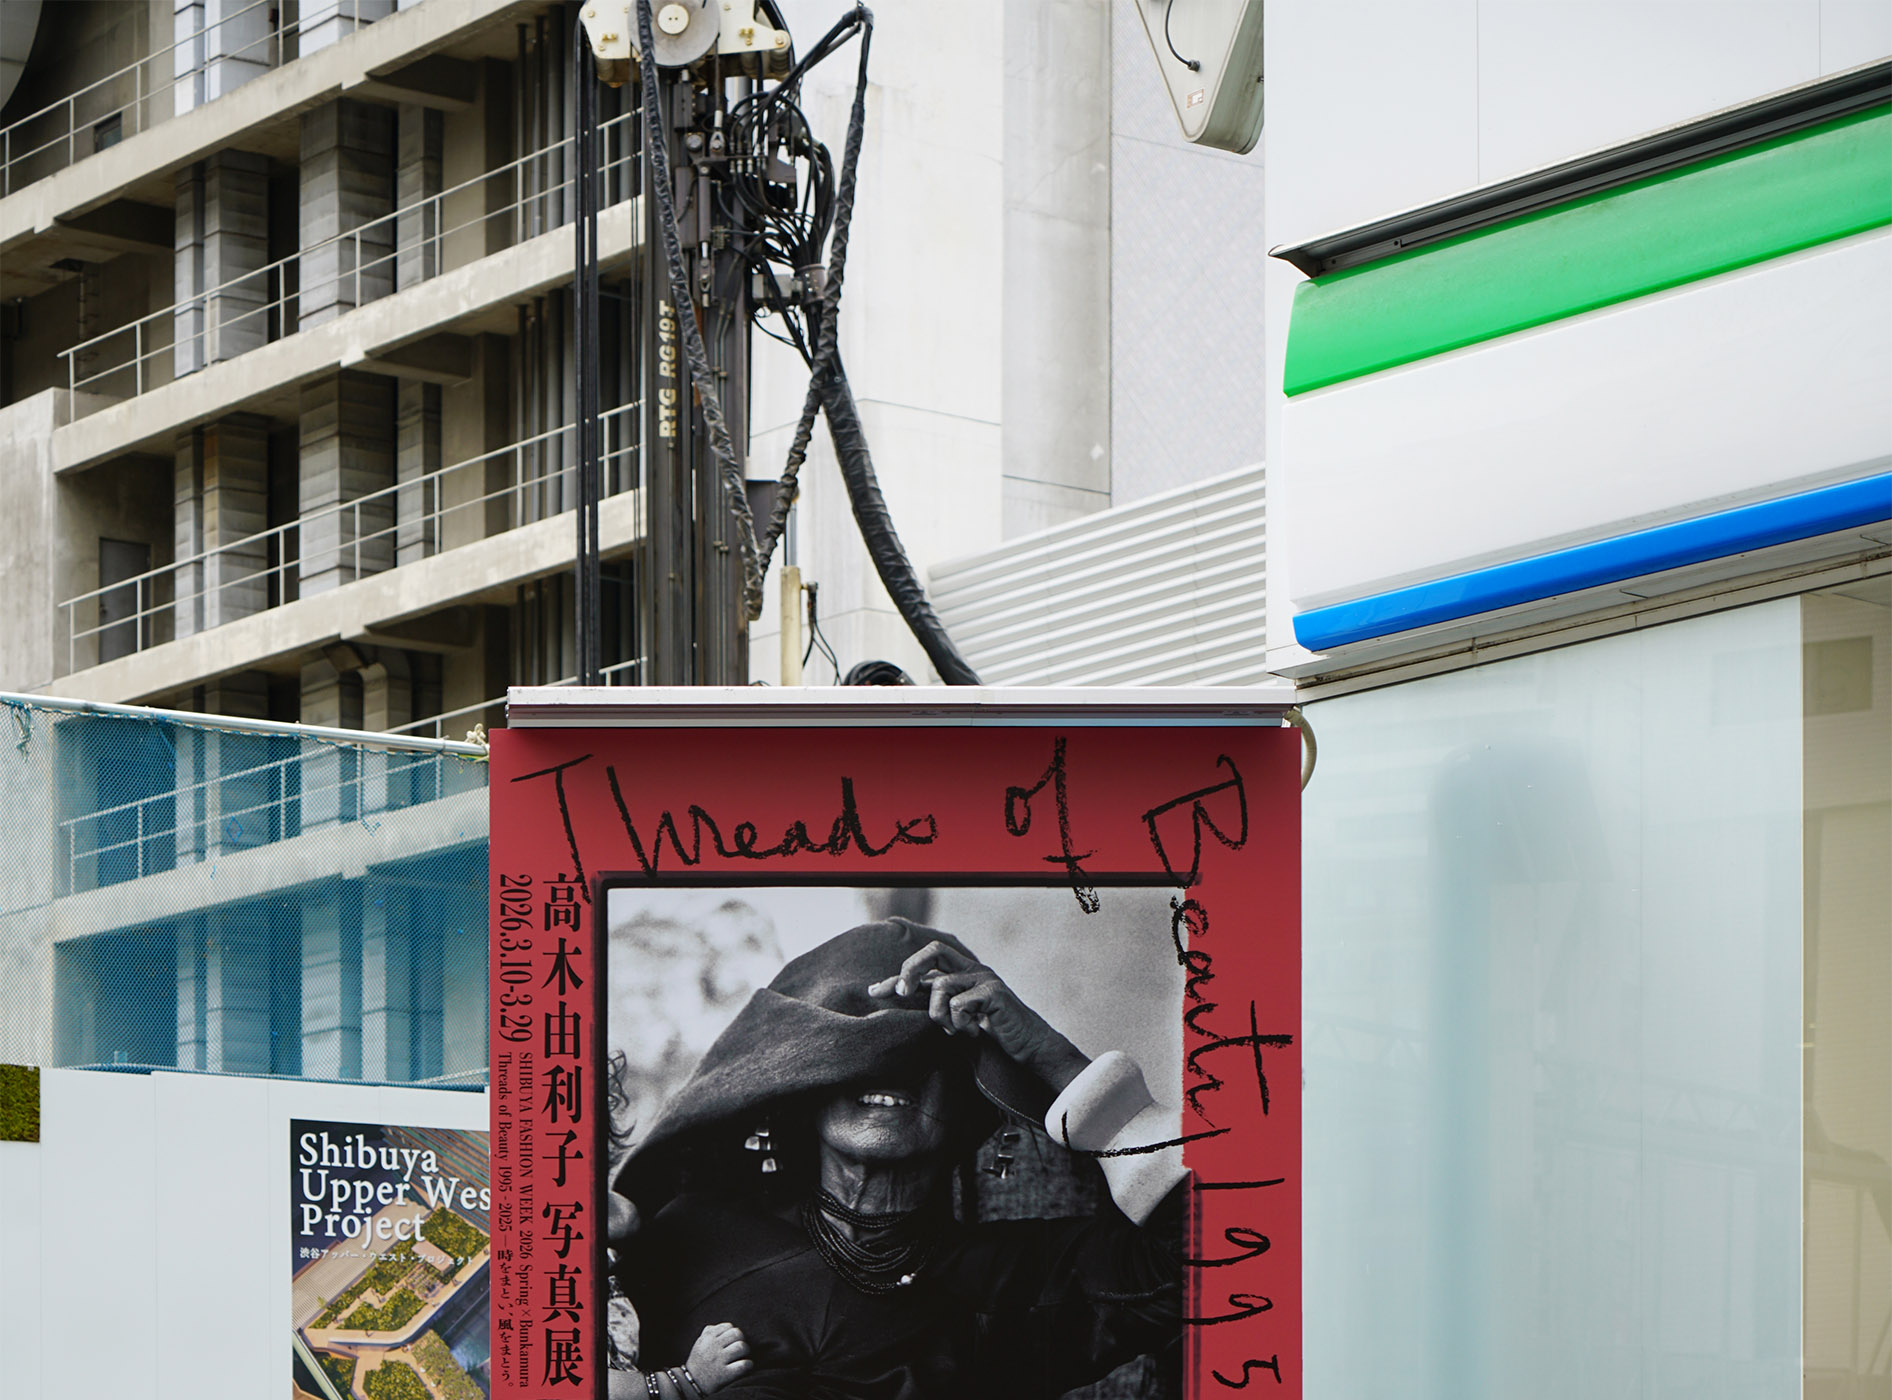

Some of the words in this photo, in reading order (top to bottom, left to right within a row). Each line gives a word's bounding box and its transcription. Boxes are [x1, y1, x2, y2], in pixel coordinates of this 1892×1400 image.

[659, 388, 676, 437] RTG
[511, 754, 939, 905] Threads
[1005, 737, 1098, 913] of
[499, 873, 533, 1043] 2026.3.10-3.29
[498, 1051, 512, 1096] Threads
[519, 1051, 533, 1112] SHIBUYA
[498, 1105, 512, 1117] of
[299, 1131, 439, 1182] Shibuya
[495, 1121, 512, 1161] Beauty
[519, 1118, 533, 1178] FASHION
[299, 1168, 410, 1214] Upper
[499, 1166, 512, 1192] 1995
[299, 1204, 426, 1249] Project
[499, 1202, 512, 1233] 2025
[519, 1184, 533, 1225] WEEK
[519, 1230, 533, 1260] 2026
[516, 1264, 533, 1306] Spring
[519, 1320, 533, 1388] Bunkamura
